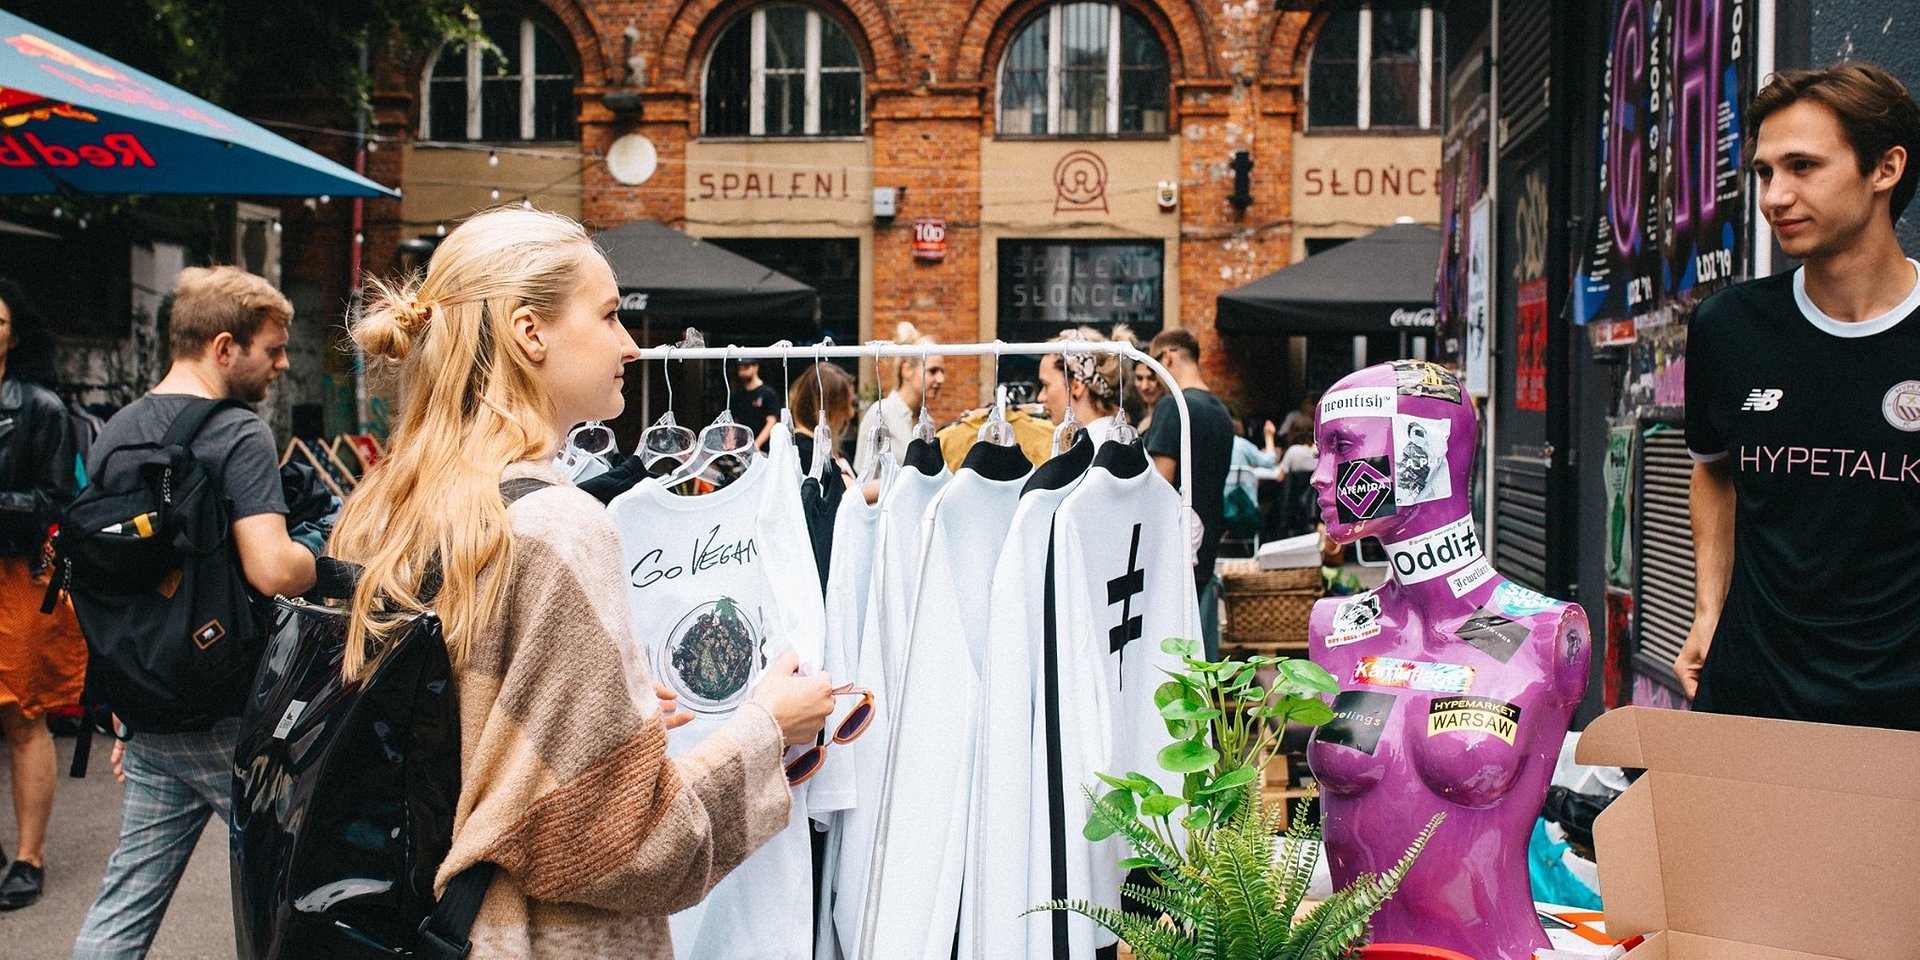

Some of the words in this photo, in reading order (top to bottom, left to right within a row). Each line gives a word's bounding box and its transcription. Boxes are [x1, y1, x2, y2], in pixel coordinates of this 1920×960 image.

[1731, 0, 1743, 61] DO
[1324, 393, 1383, 413] neonfish
[1434, 700, 1516, 718] HYPEMARKET
[1433, 711, 1513, 738] WARSAW
